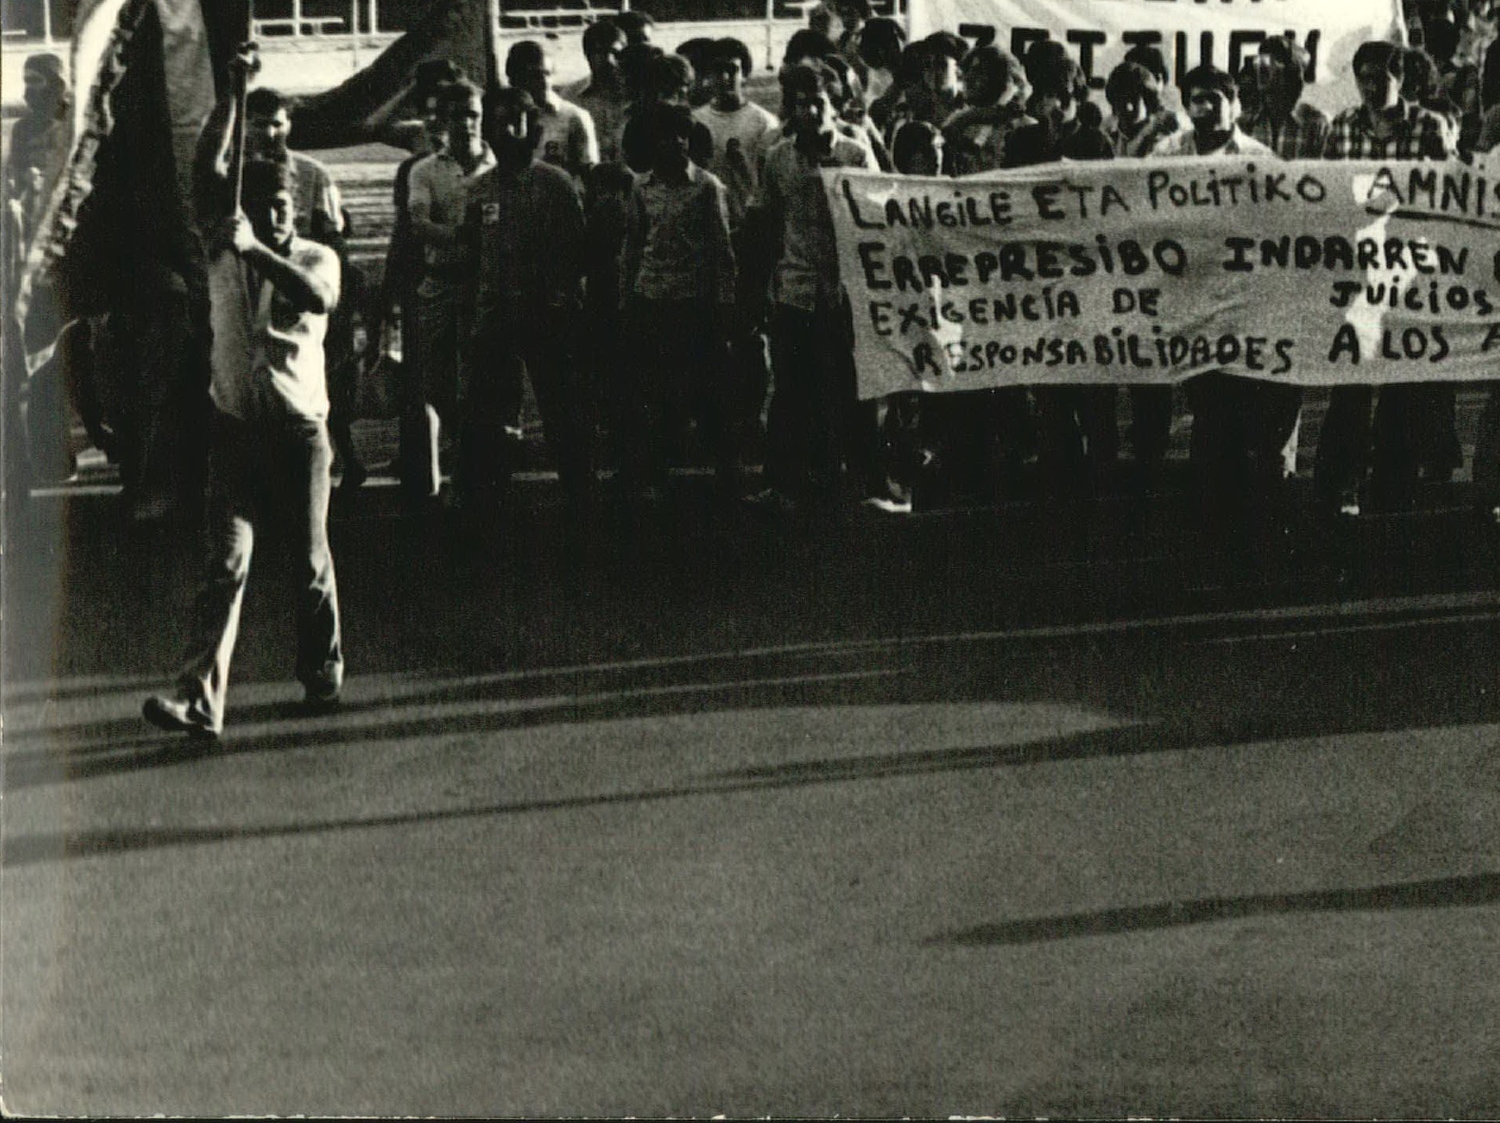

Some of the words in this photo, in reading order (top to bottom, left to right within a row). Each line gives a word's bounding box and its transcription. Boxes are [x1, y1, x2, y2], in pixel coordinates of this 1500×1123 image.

[1031, 184, 1130, 221] ETA
[1223, 236, 1468, 276] INDARREN
[1112, 287, 1160, 317] DE
[1328, 325, 1361, 365] A
[1382, 326, 1450, 363] LOS
